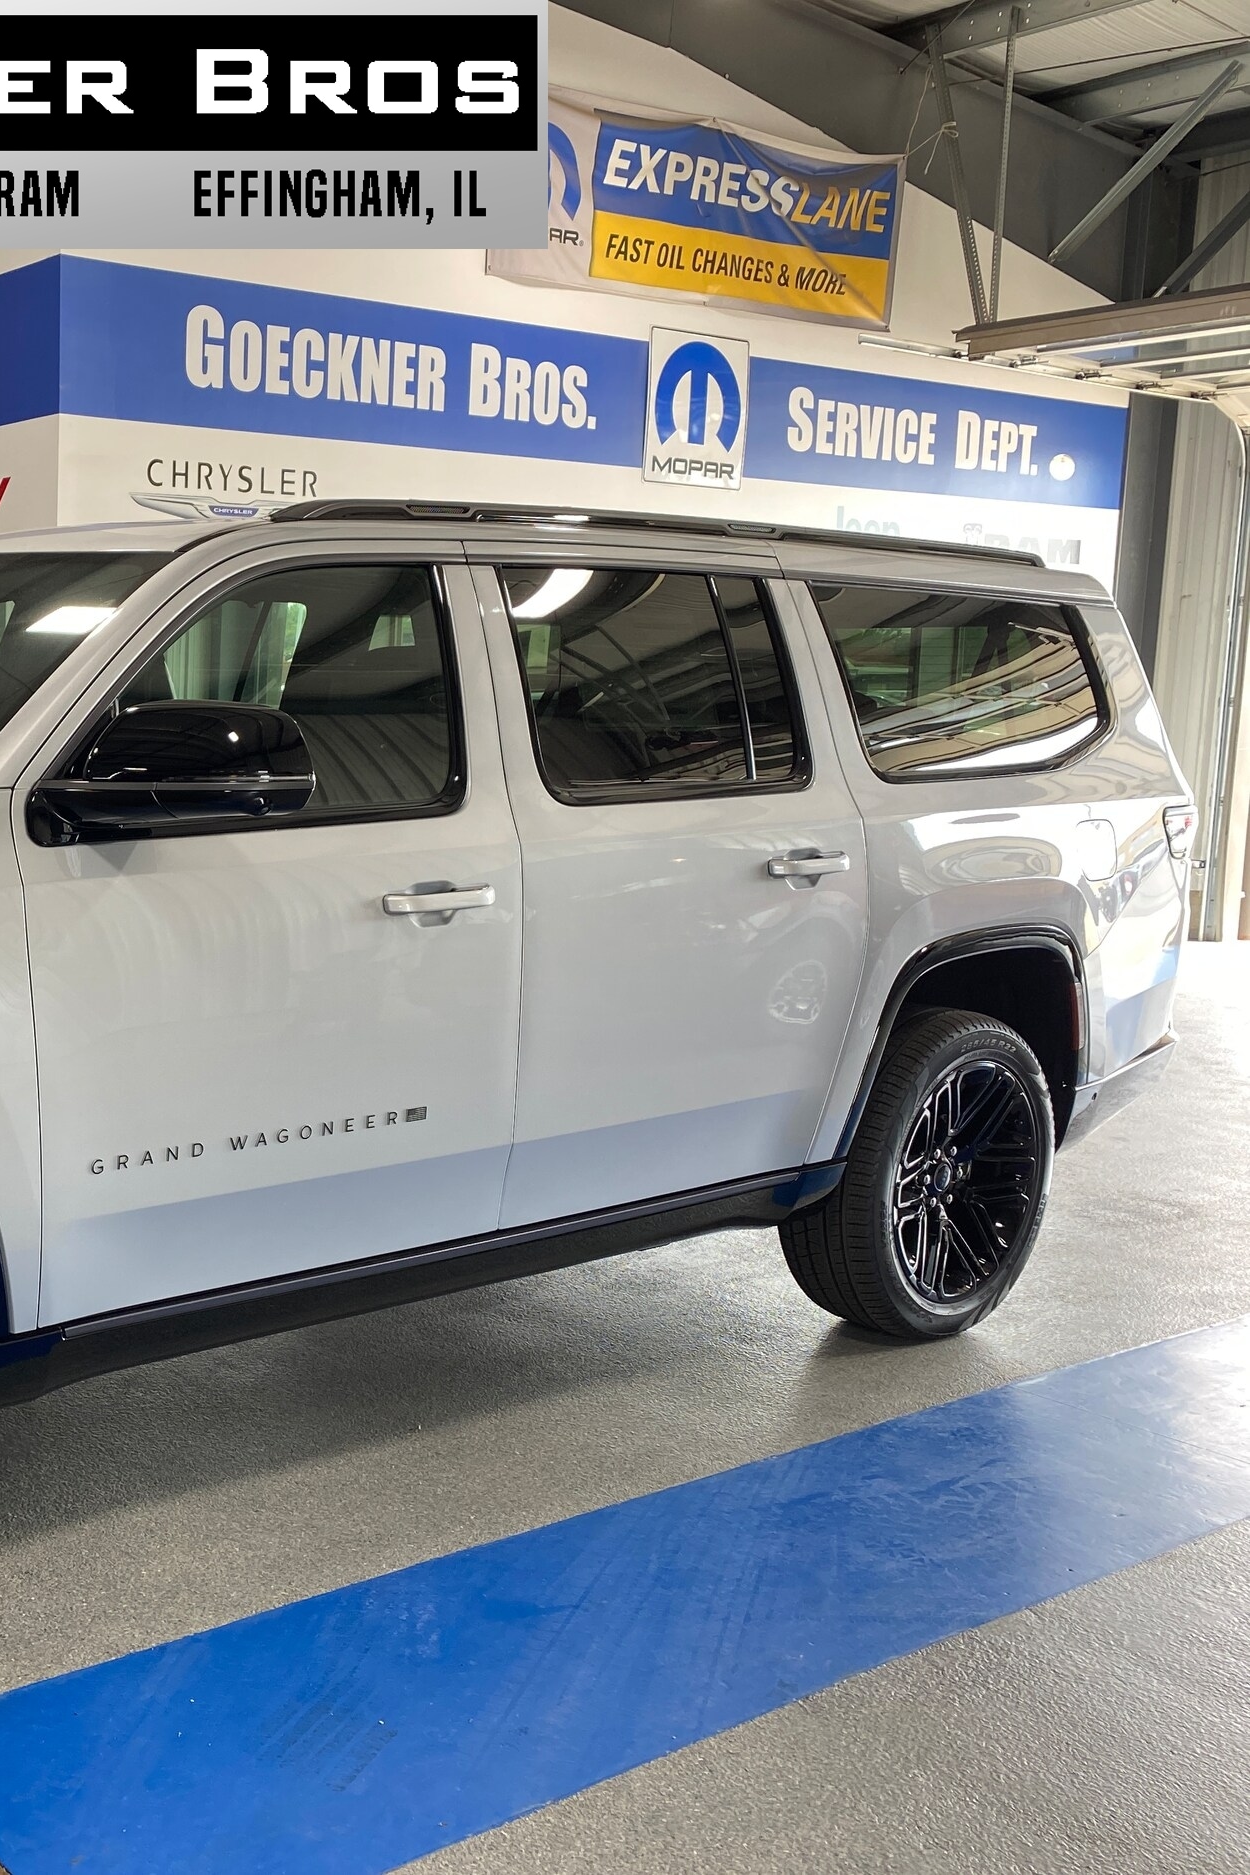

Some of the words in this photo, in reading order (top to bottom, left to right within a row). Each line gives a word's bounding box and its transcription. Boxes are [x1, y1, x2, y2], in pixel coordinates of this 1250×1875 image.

[605, 233, 655, 265] FAST
[656, 242, 686, 271] OIL
[691, 247, 773, 285] CHANGES
[776, 266, 791, 288] &
[794, 264, 848, 297] MORE
[185, 304, 447, 412] GOECKNER
[468, 342, 597, 430] BROS.
[787, 386, 938, 466] SERVICE
[955, 409, 1039, 477] DEPT.
[146, 458, 318, 498] CHRYSLER
[651, 455, 735, 480] MOPAR
[213, 507, 254, 516] CHRYSLER
[90, 1141, 205, 1176] GRAND
[229, 1110, 399, 1153] WAGONEER
